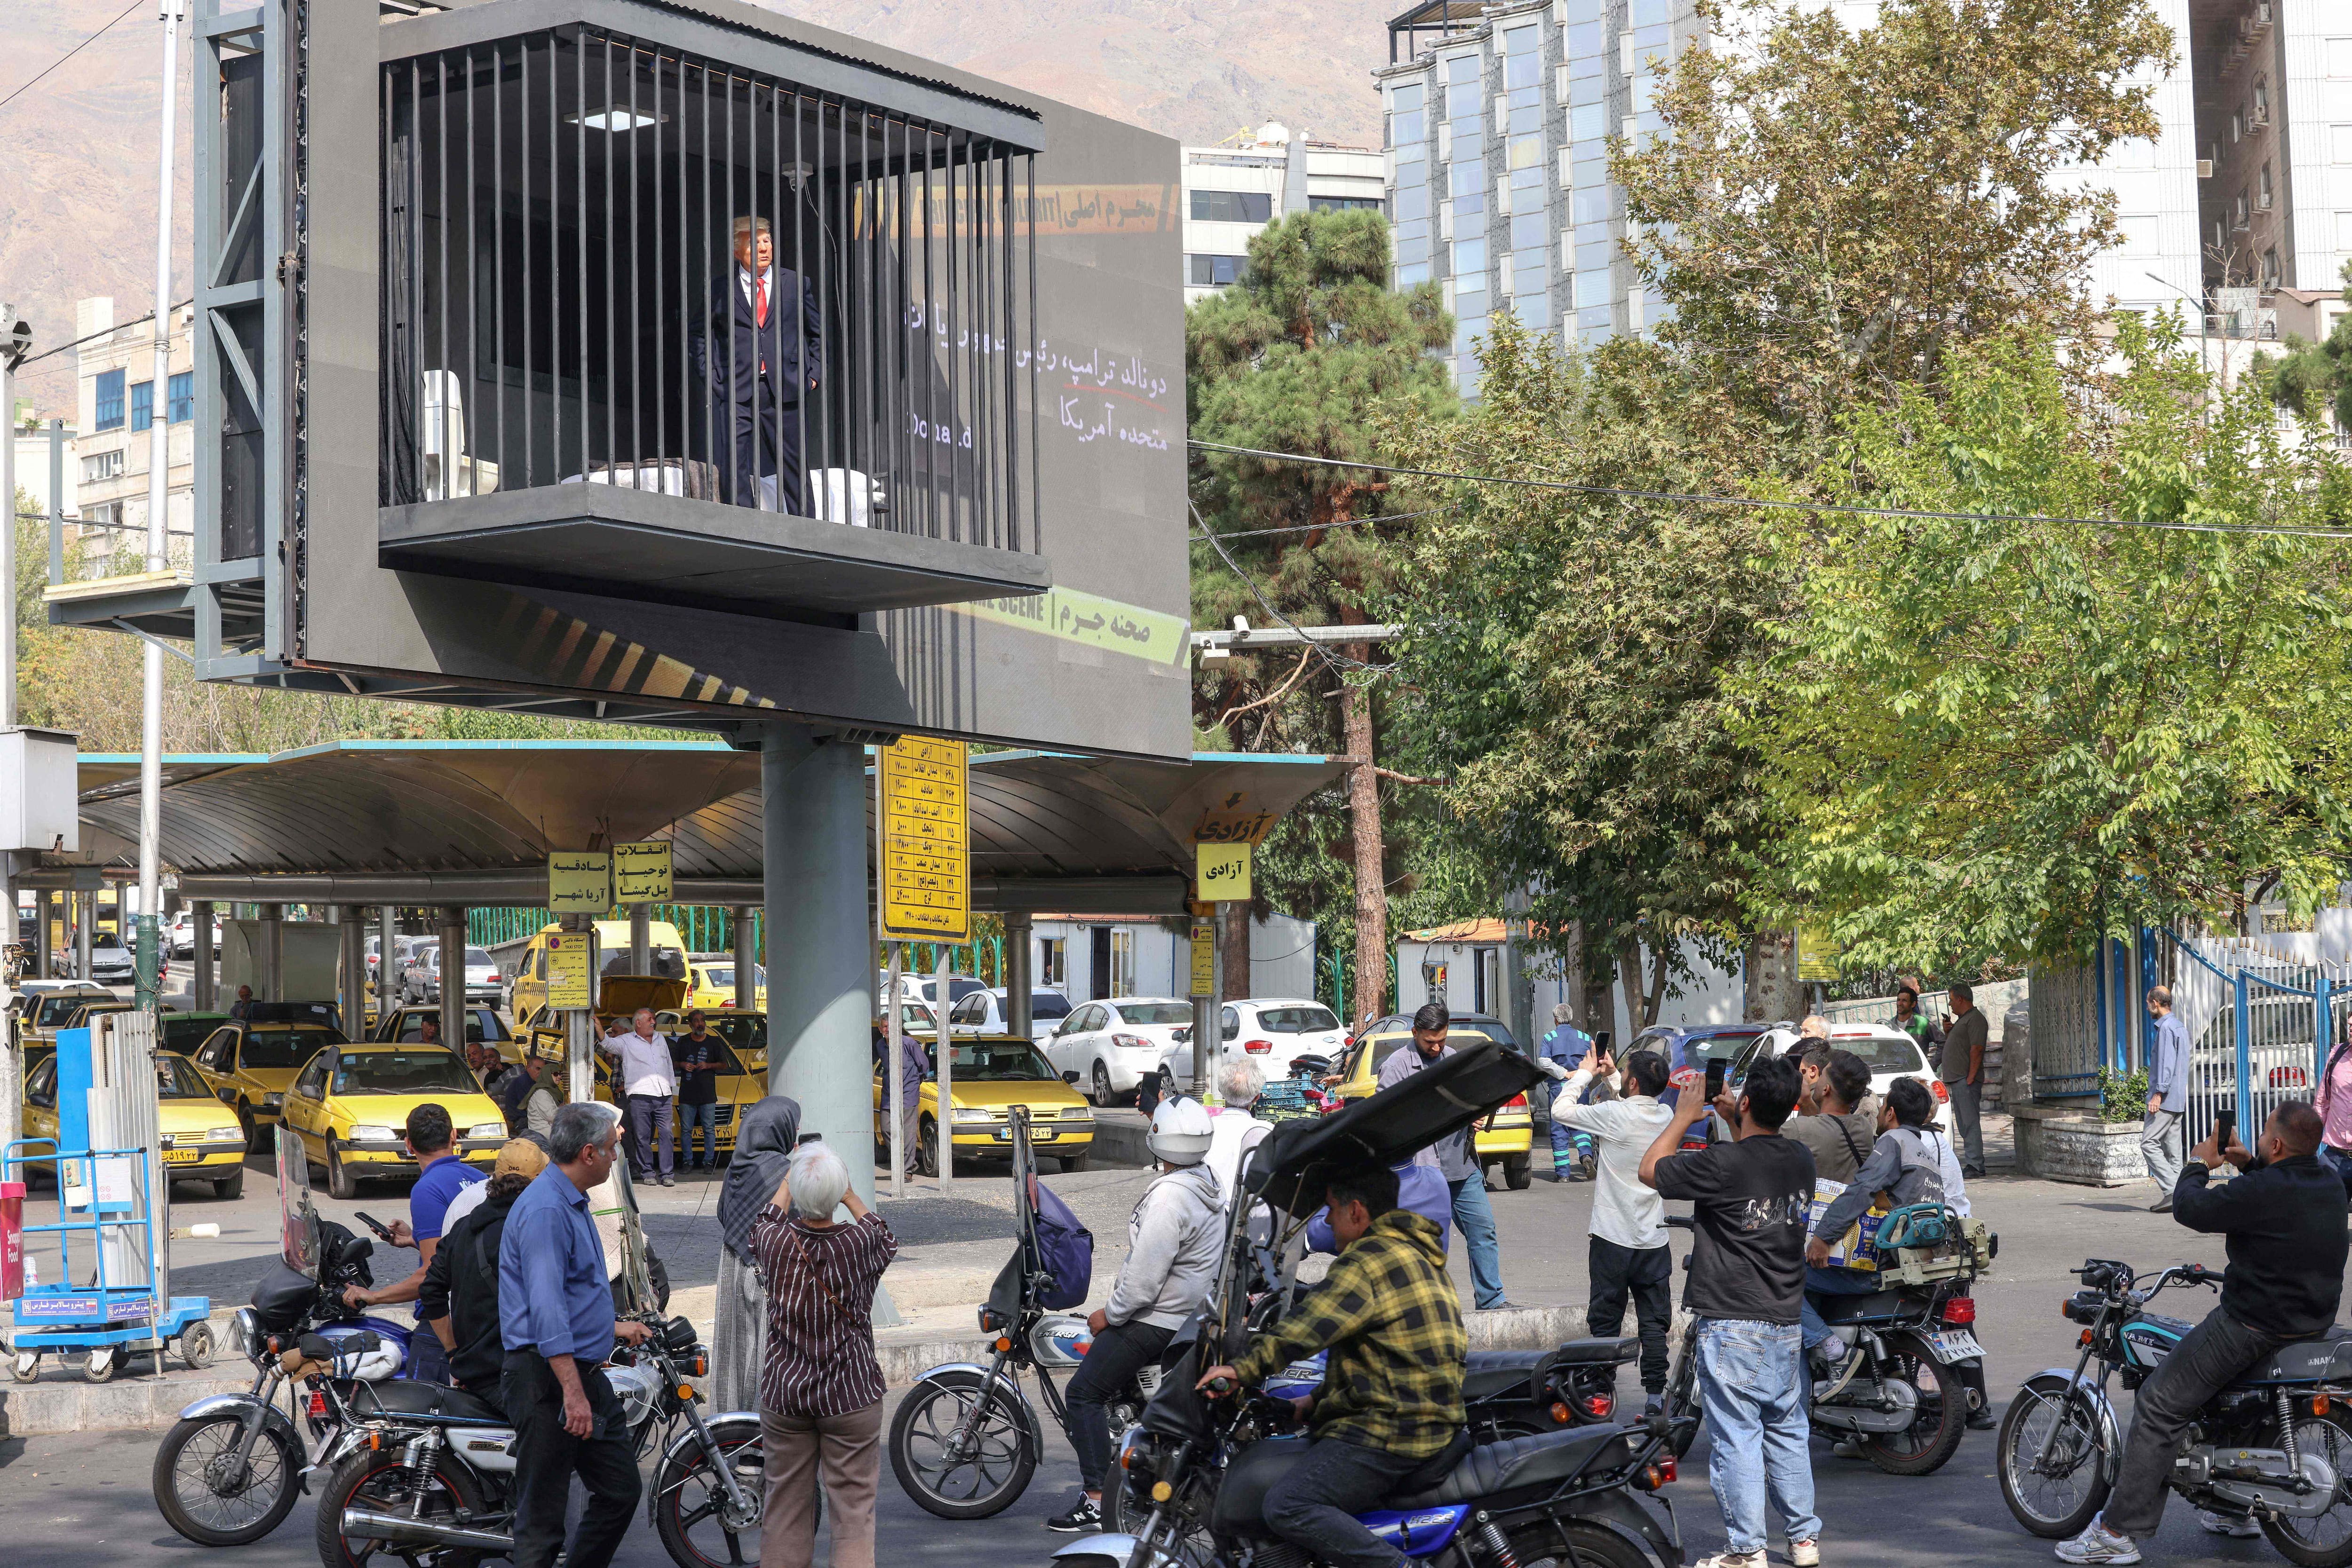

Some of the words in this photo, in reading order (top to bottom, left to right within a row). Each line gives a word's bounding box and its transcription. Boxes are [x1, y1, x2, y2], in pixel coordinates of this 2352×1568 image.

[1064, 190, 1101, 228] اصلی
[1105, 199, 1156, 227] مجرم
[1121, 357, 1166, 398] دونالد
[1060, 395, 1114, 443] آمریکا
[1120, 428, 1167, 451] متحده
[1060, 605, 1105, 640] جرم
[1110, 614, 1151, 642] صحنه
[921, 745, 932, 759] آزادی
[914, 762, 926, 774] انقلاب
[927, 764, 938, 777] میدان
[921, 784, 933, 796] صادقیه
[616, 844, 667, 857] انقلاب
[552, 860, 607, 872] صادقیه
[916, 858, 927, 867] صنعت
[930, 858, 940, 871] میدان
[618, 865, 667, 879] توحید
[1206, 860, 1244, 879] آزادی
[552, 888, 584, 902] شهر
[586, 888, 606, 903] آریا
[620, 886, 651, 897] گیشا
[651, 885, 668, 898] پل
[8, 1246, 18, 1264] Food
[32, 1301, 49, 1310] فارس
[50, 1301, 70, 1310] بالابر
[71, 1300, 84, 1309] پیشرو
[114, 1305, 126, 1314] فارس
[1038, 1330, 1080, 1339] ENERGI
[2123, 1331, 2154, 1346] NAMI
[1621, 1344, 1637, 1354] BOXER
[961, 1406, 978, 1440] ENERGI
[1073, 1512, 1087, 1522] N
[1410, 1514, 1454, 1524] H225
